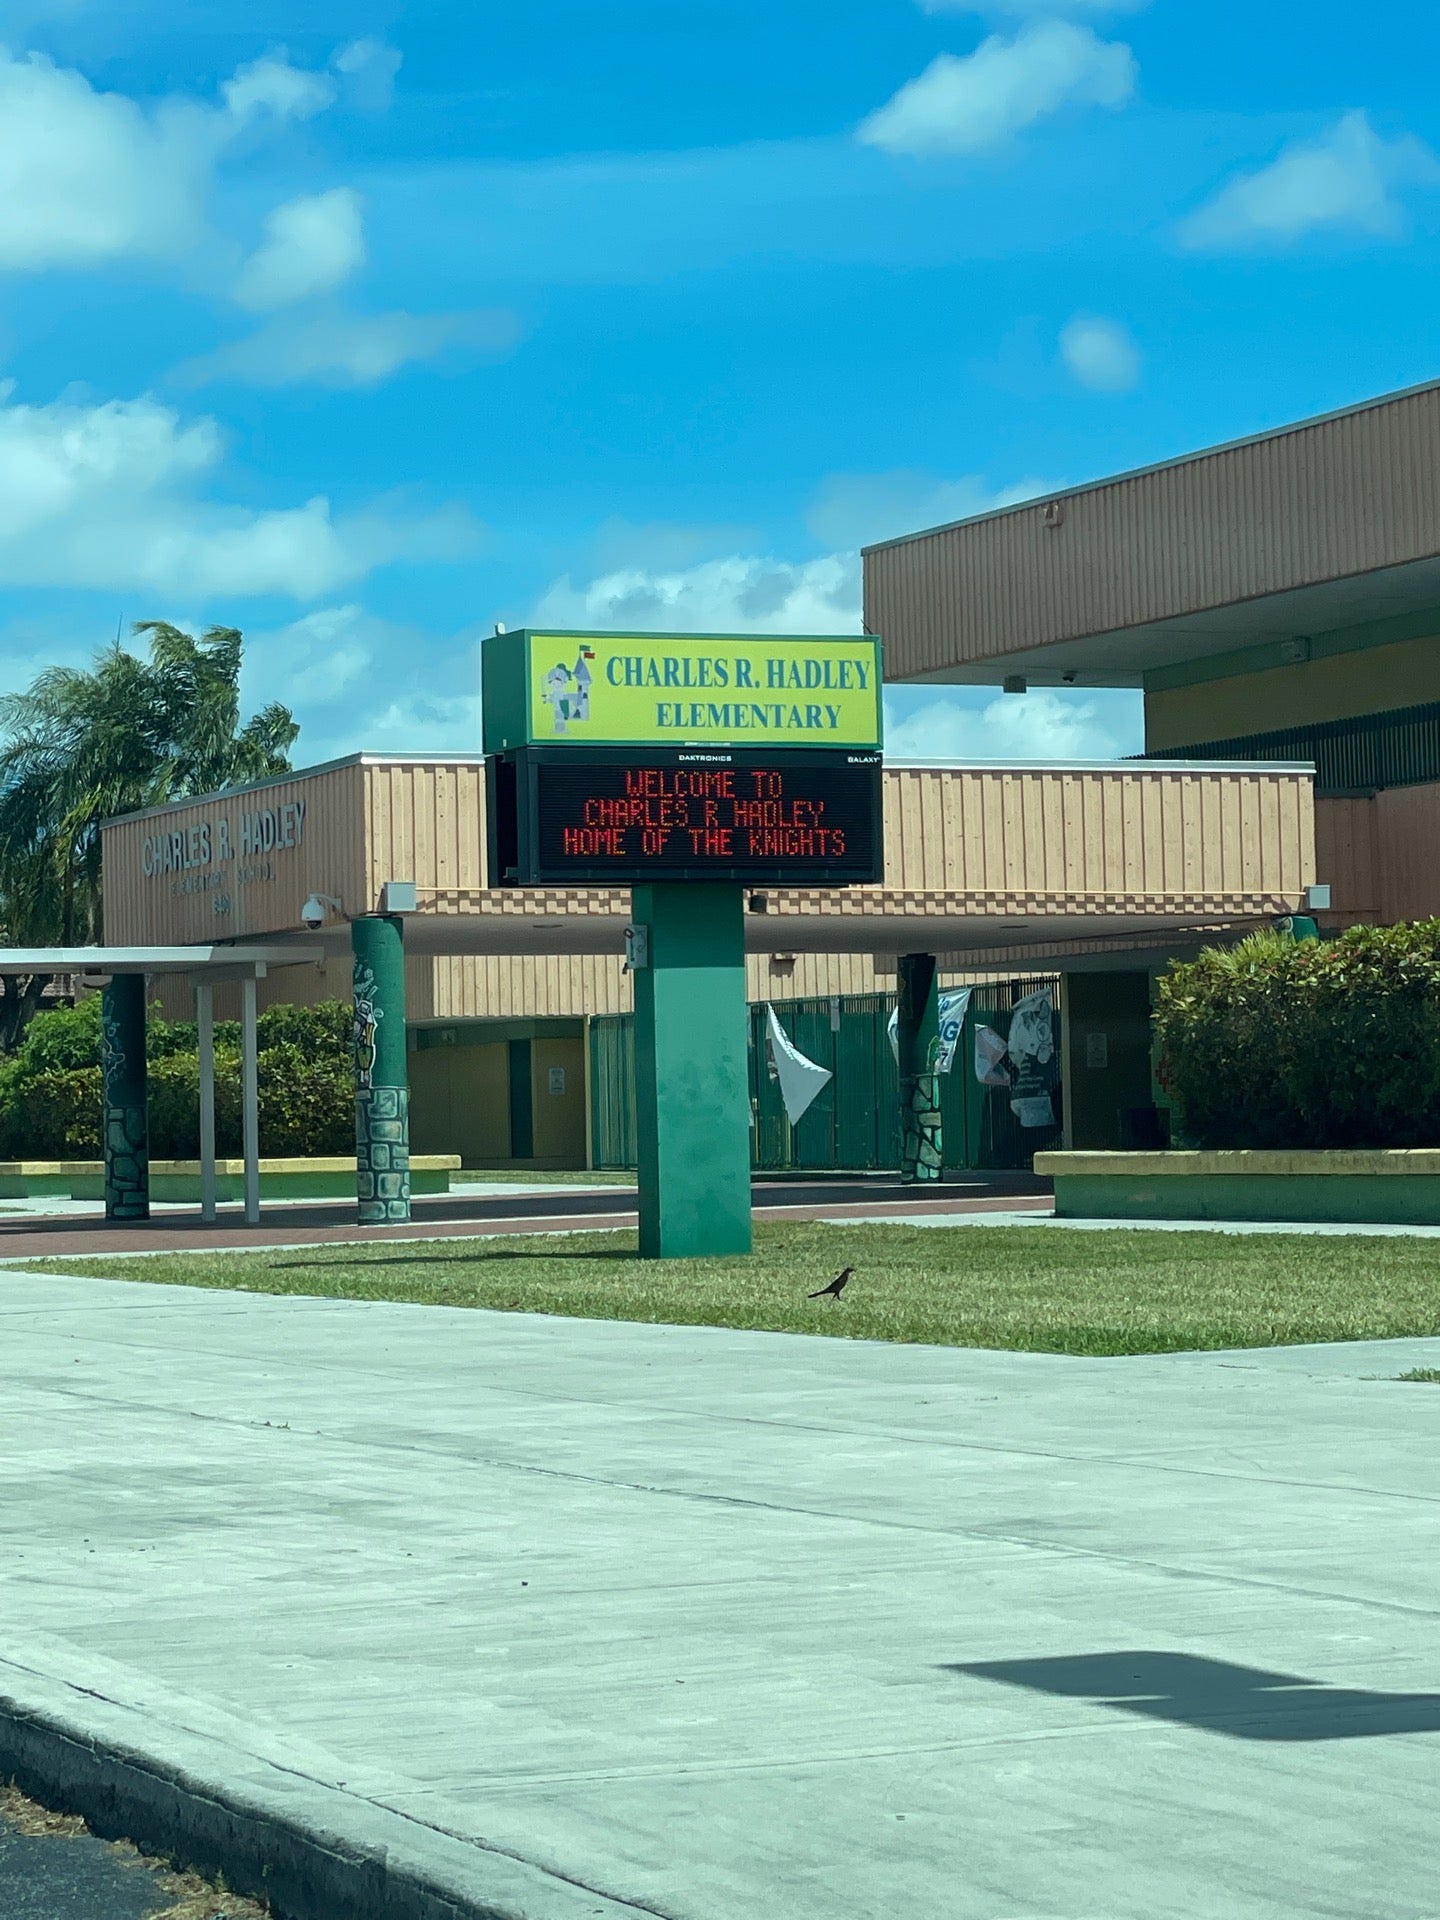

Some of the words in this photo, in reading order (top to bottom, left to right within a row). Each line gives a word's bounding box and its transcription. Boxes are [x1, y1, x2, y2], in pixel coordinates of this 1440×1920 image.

[606, 656, 729, 687] CHARLES
[735, 658, 761, 688] R.
[766, 659, 871, 689] HADLEY
[656, 703, 842, 729] ELEMENTARY
[678, 755, 732, 763] DAKTRONICS
[625, 770, 736, 798] WELCOME
[751, 771, 783, 798] TO
[584, 799, 689, 827] CHARLES
[704, 800, 719, 827] R
[733, 800, 825, 827] HADLEY
[142, 824, 211, 877] CHARLES
[216, 818, 234, 861] R.
[240, 800, 305, 856] HADLEY
[563, 828, 626, 855] HOME
[642, 829, 671, 855] OF
[688, 829, 733, 855] THE
[749, 829, 846, 856] KNIGHTS
